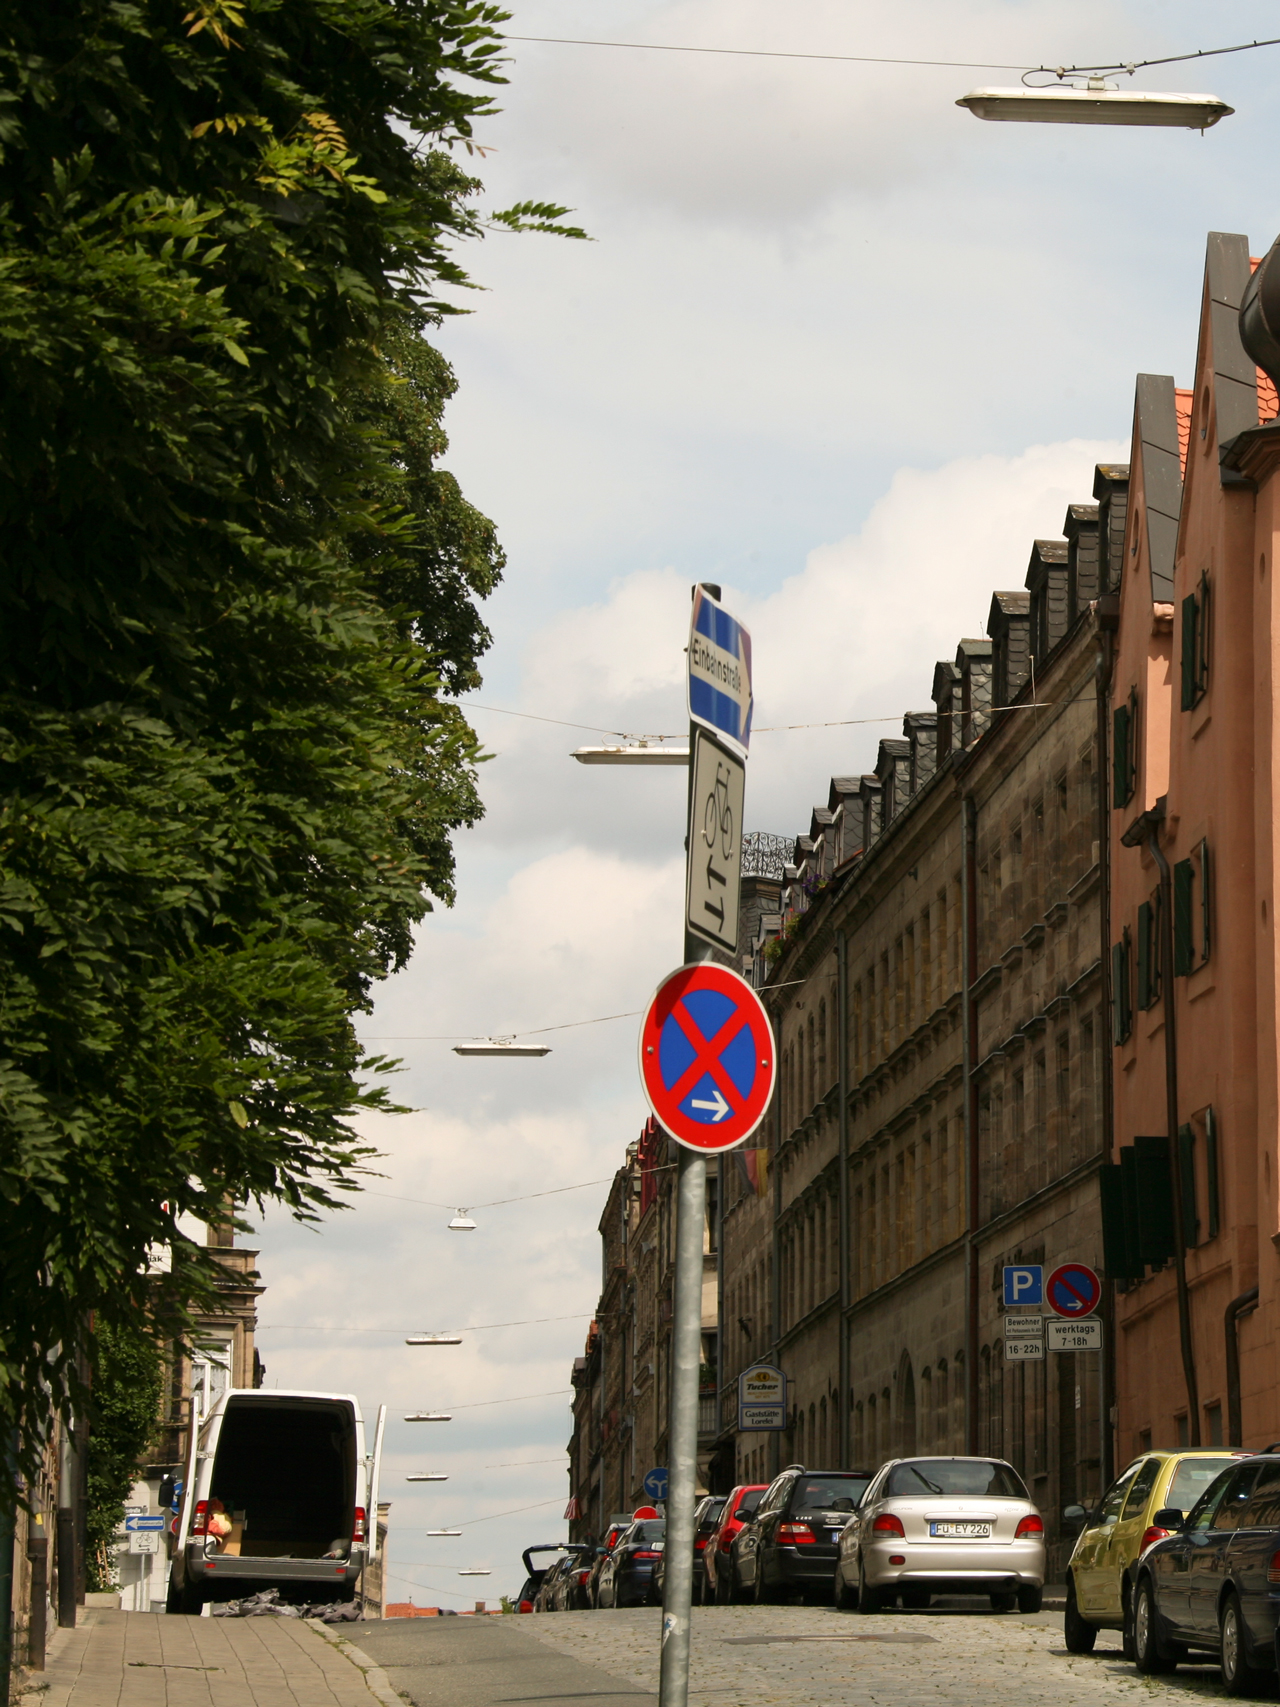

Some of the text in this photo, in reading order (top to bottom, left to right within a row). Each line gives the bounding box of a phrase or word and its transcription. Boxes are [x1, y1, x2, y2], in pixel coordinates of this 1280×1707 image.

[693, 638, 742, 692] Einbahnstraße
[1012, 1271, 1034, 1300] P
[1007, 1318, 1040, 1326] Bewohner
[1055, 1324, 1095, 1335] werktags
[746, 1383, 779, 1391] Tucher
[745, 1410, 780, 1418] Gaststätte
[936, 1523, 988, 1534] FÜ EY 226
